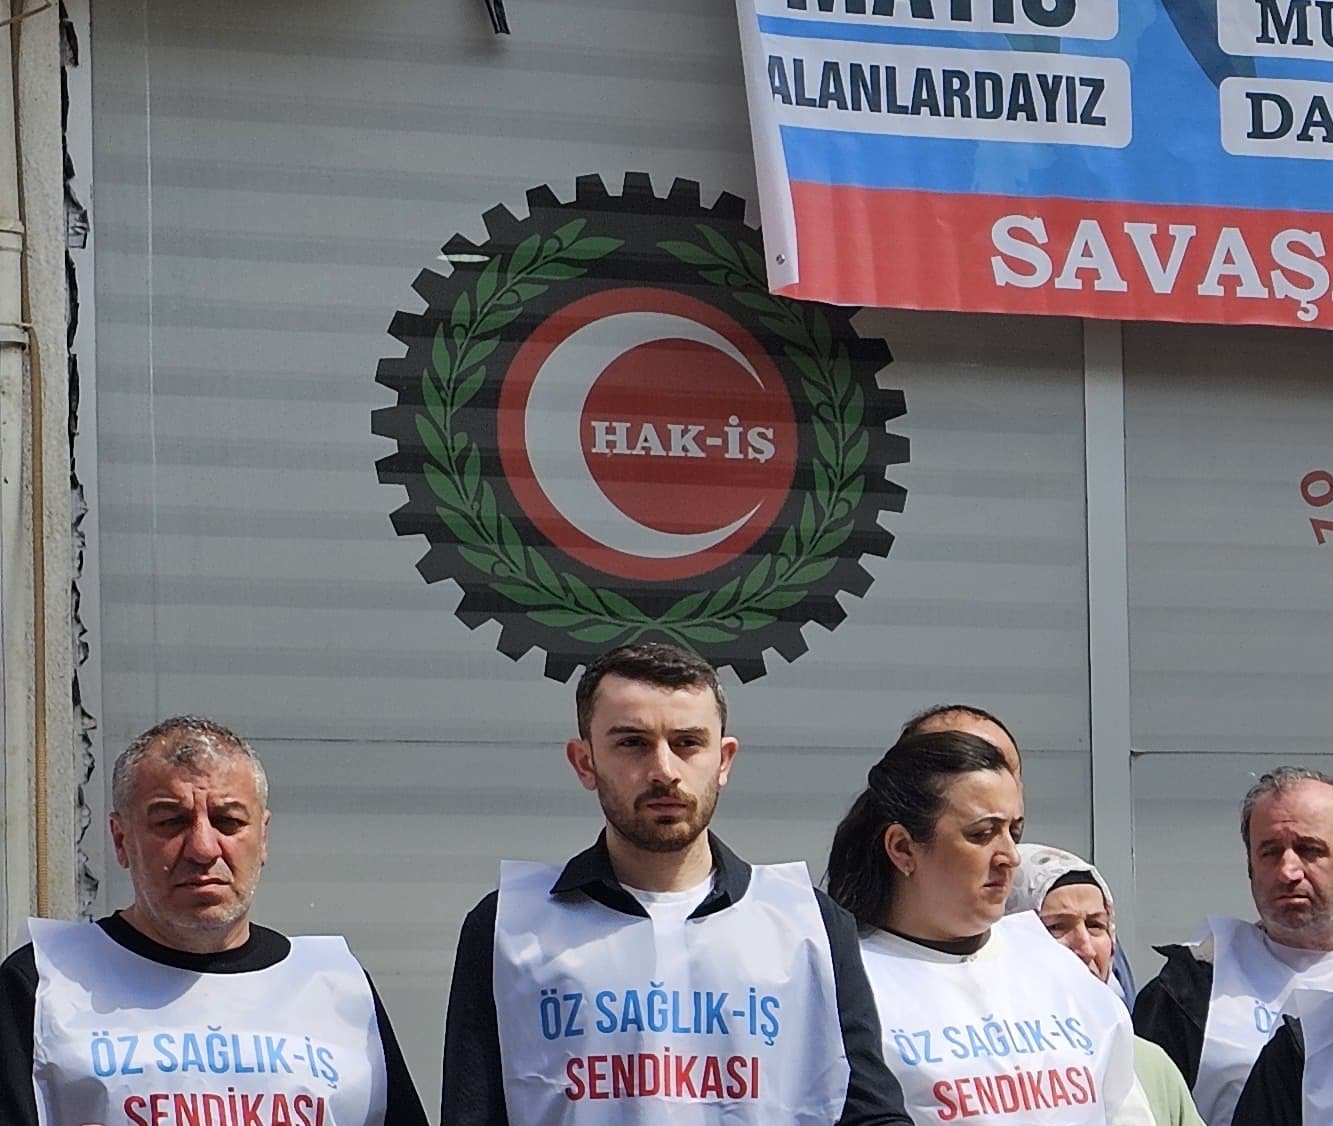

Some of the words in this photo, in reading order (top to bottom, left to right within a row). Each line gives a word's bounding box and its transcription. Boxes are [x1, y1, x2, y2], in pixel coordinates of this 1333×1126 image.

[768, 54, 1106, 126] ALANLARDAYIZ
[590, 415, 776, 463] HAK-İŞ
[540, 990, 584, 1041] ÖZ
[595, 982, 780, 1046] SAĞLIK-İŞ
[892, 1028, 934, 1066] ÖZ
[950, 1015, 1092, 1060] SAĞLIK-İŞ
[91, 1031, 143, 1077] ÖZ
[156, 1025, 340, 1088] SAĞLIK-İŞ
[565, 1046, 760, 1101] SENDİKASI
[933, 1065, 1097, 1121] SENDİKASI
